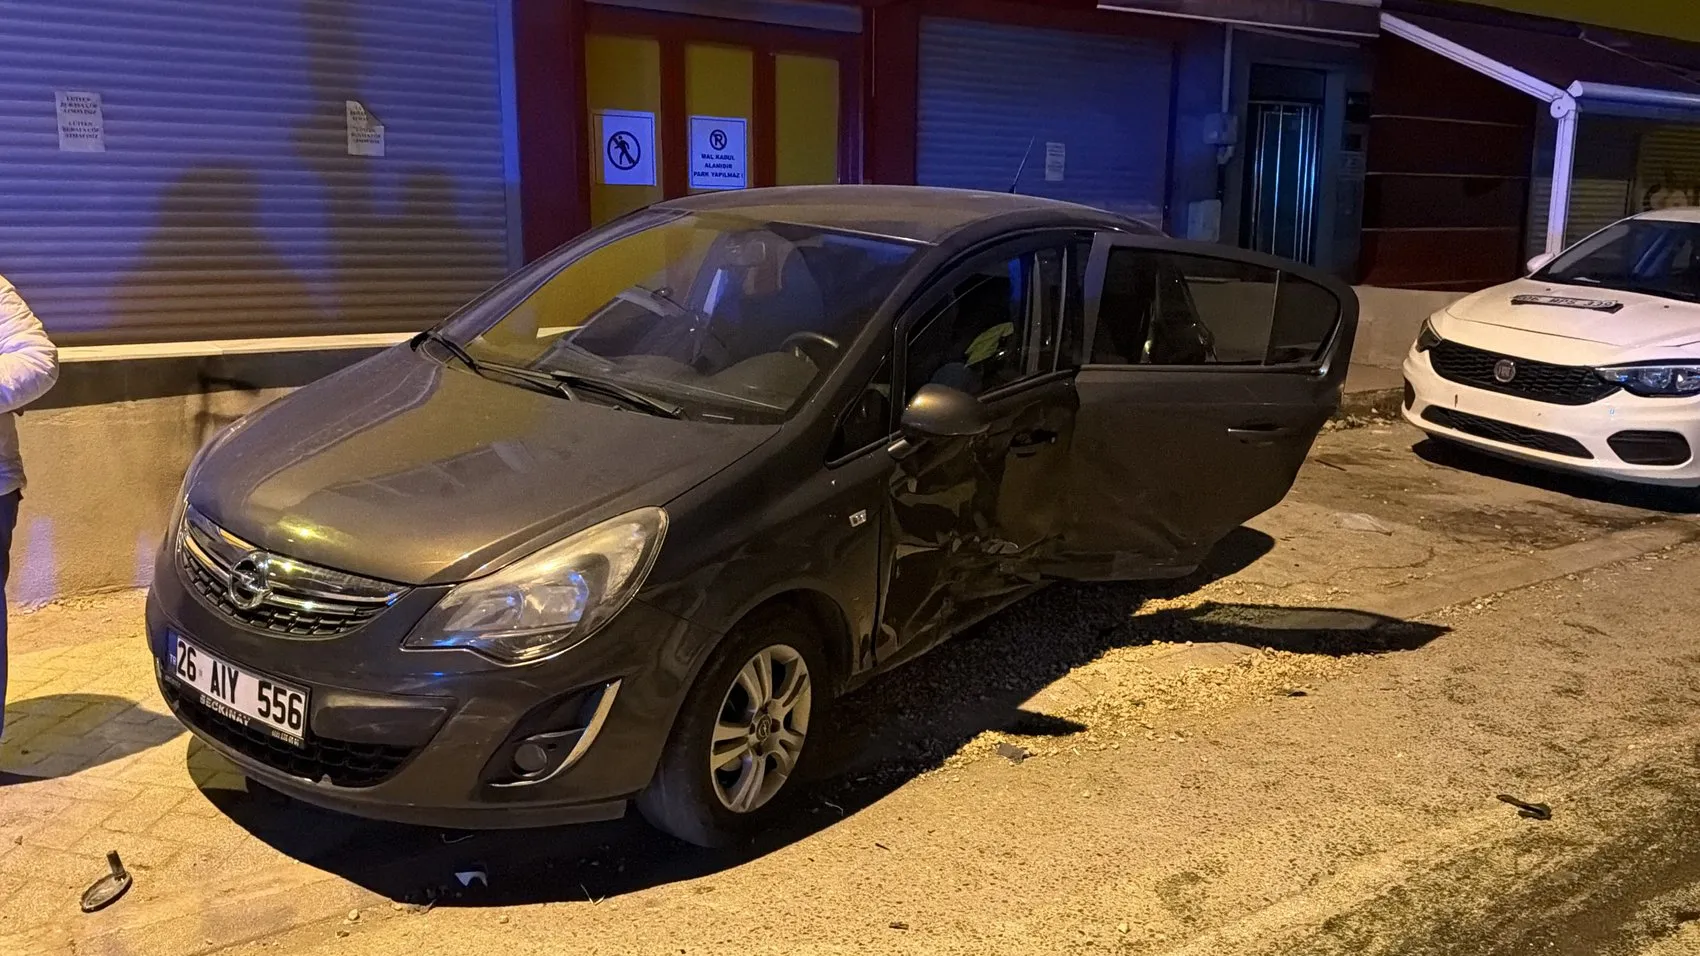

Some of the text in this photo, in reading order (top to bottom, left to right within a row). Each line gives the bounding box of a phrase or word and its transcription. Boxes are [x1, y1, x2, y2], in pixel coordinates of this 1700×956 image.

[177, 640, 197, 682] 26
[210, 661, 239, 704] AIY
[257, 680, 303, 731] 556
